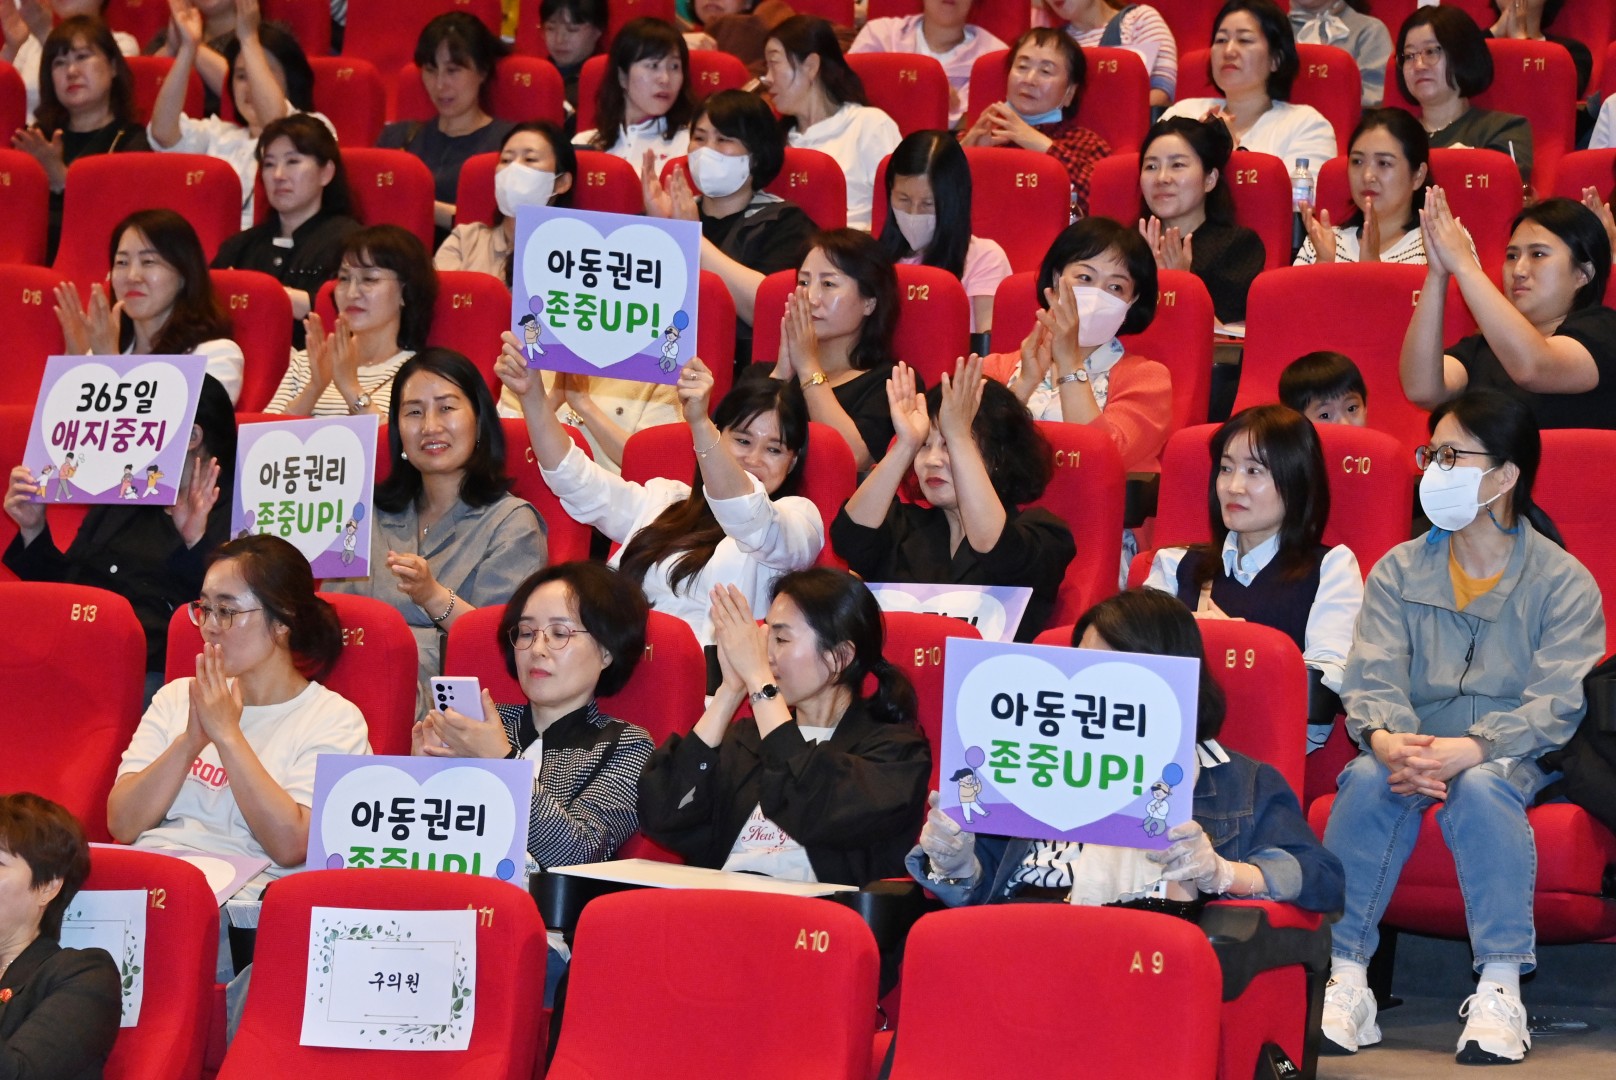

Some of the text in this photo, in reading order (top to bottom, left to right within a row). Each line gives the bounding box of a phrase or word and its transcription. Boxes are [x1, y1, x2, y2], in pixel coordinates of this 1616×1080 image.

[1098, 60, 1118, 74] F13
[1307, 64, 1327, 78] F12
[790, 172, 807, 188] E14
[1015, 172, 1037, 188] E13
[1236, 169, 1258, 185] E12
[548, 249, 662, 291] 아동권리
[22, 288, 42, 306] D16
[452, 293, 472, 309] D14
[907, 284, 929, 301] D12
[546, 290, 660, 338] 존중UP!
[76, 380, 157, 414] 365일
[51, 418, 167, 453] 애지중지
[260, 455, 345, 495] 아동권리
[1342, 455, 1371, 475] C10
[256, 499, 344, 537] 존중UP!
[70, 603, 98, 623] B13
[914, 646, 941, 667] B10
[991, 690, 1146, 740] 아동권리
[190, 756, 228, 787] ROO
[988, 740, 1145, 796] 존중UP!
[351, 797, 486, 841] 아동권리
[793, 928, 828, 952] A10
[368, 971, 420, 994] 구의원
